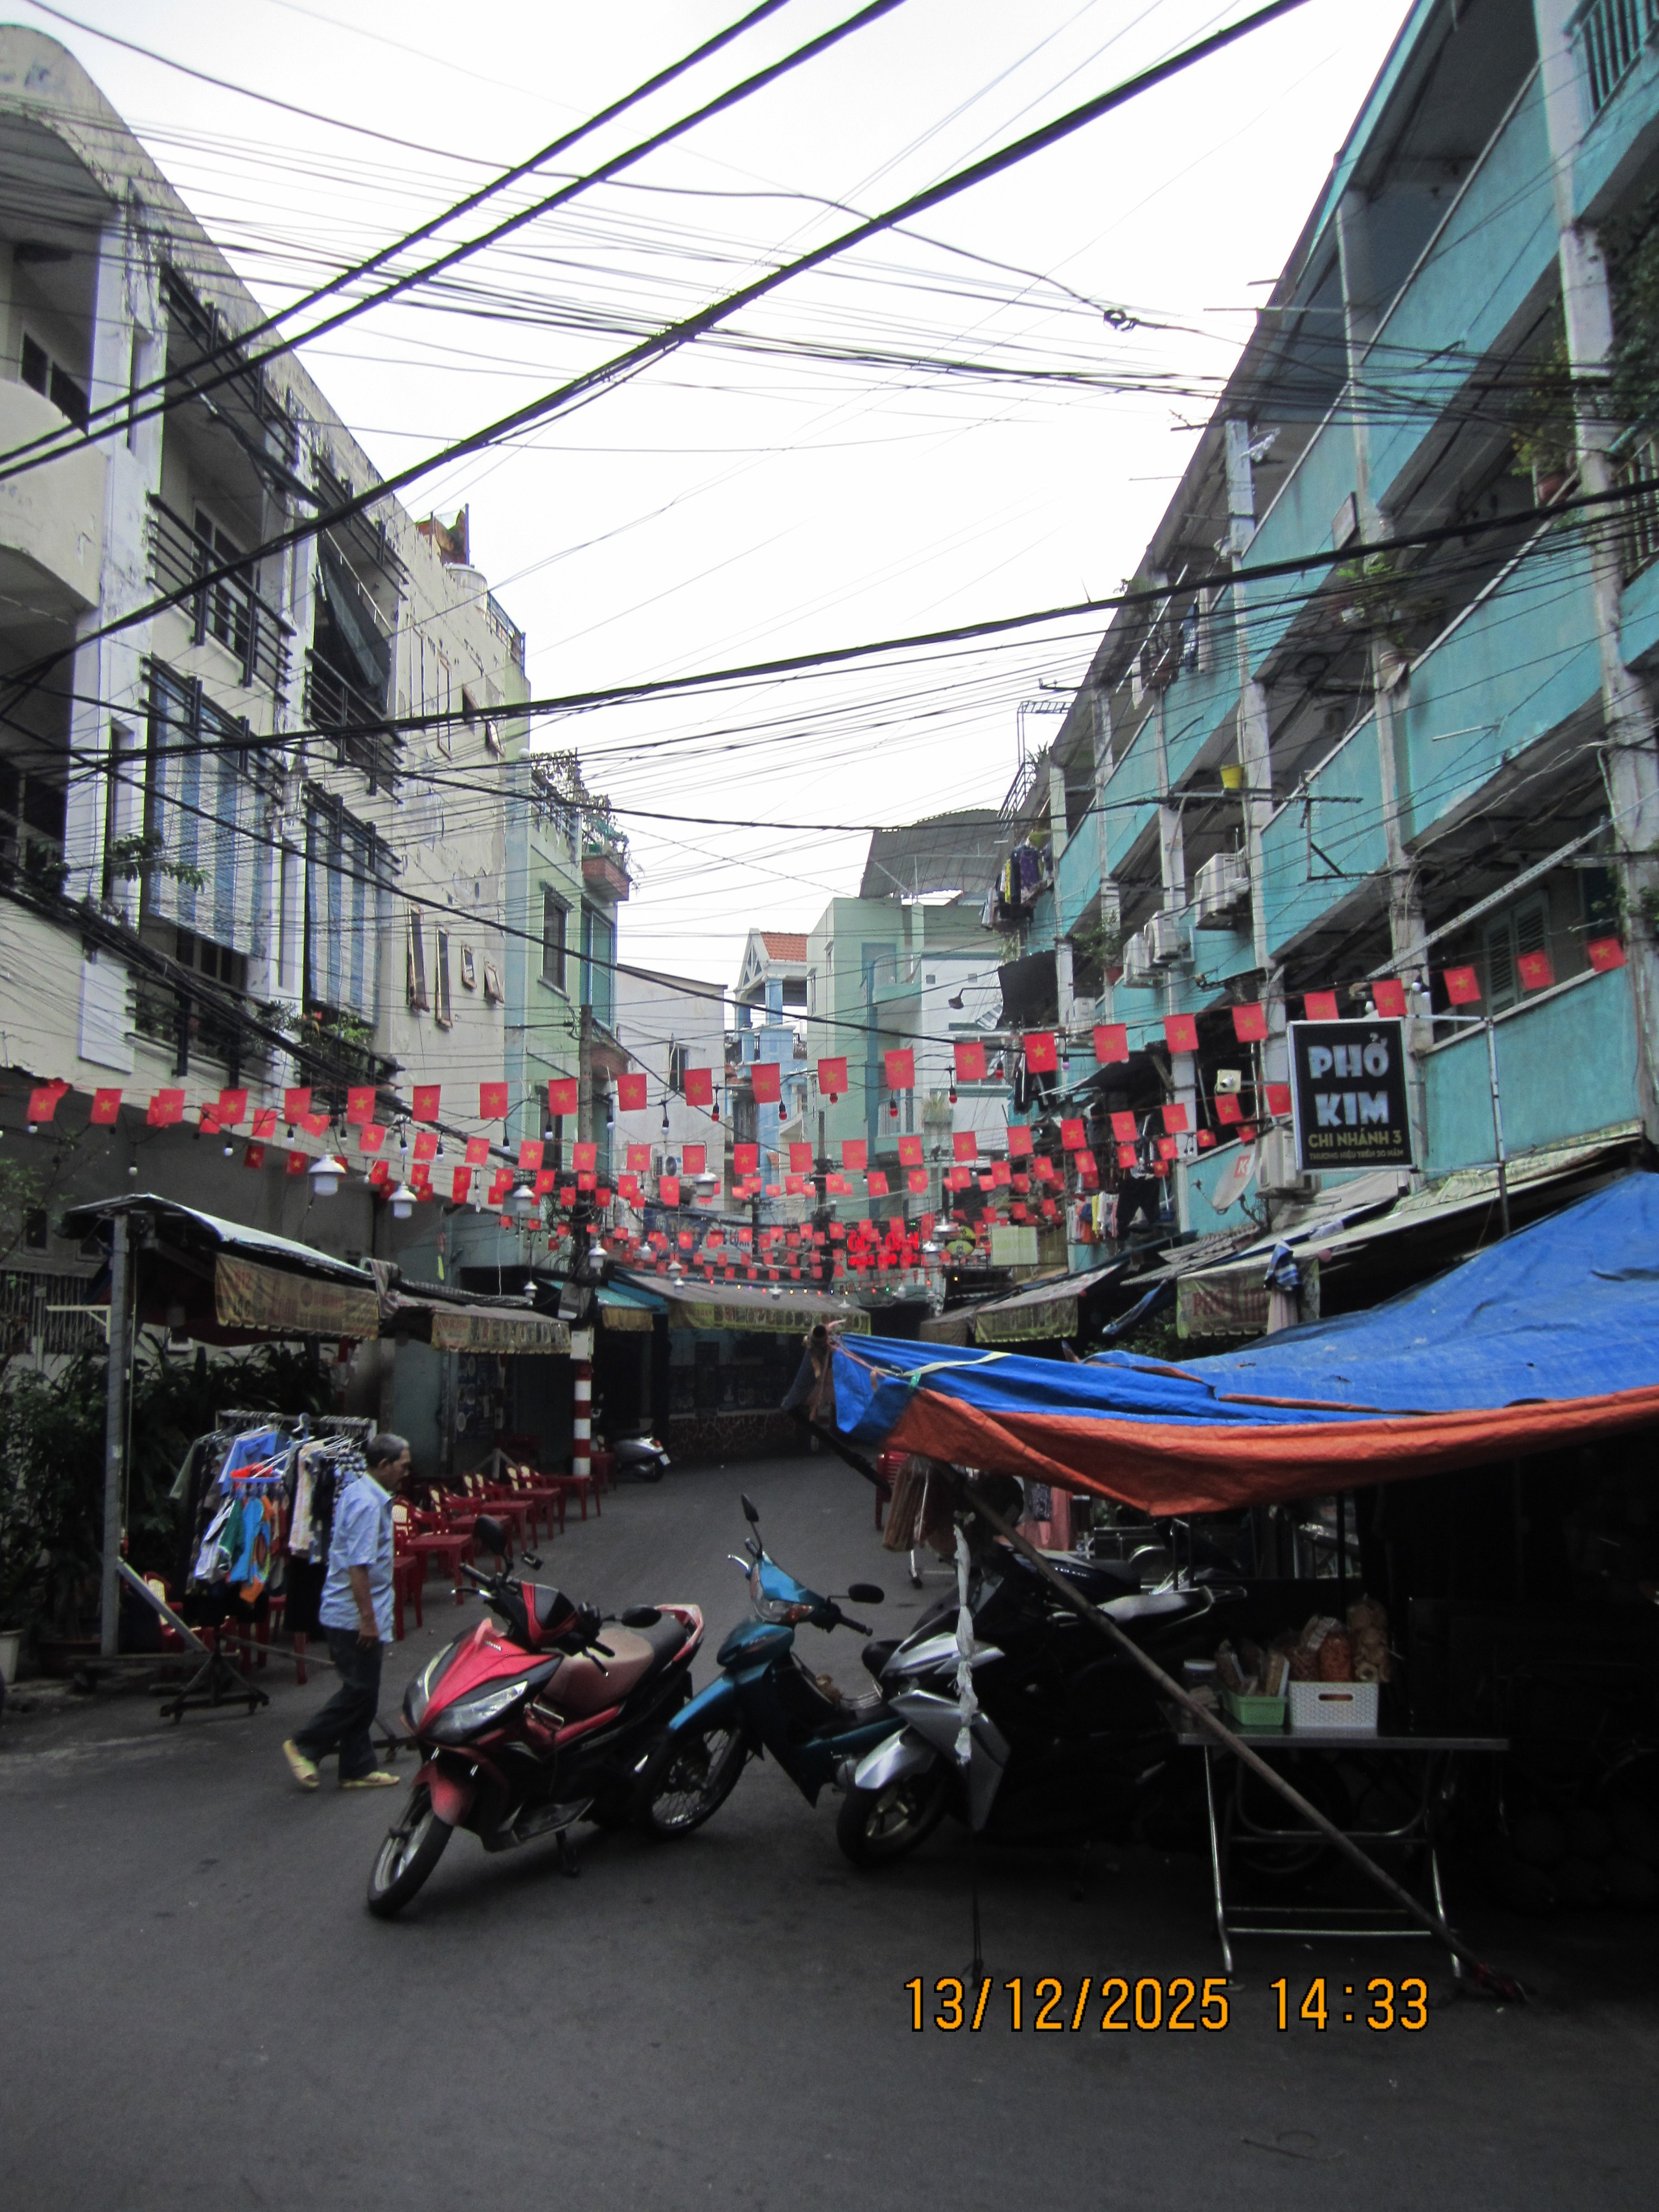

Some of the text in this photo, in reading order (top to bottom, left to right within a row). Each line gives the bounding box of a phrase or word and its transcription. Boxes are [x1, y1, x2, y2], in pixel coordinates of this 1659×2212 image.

[1308, 1032, 1389, 1078] PHỞ
[1315, 1090, 1389, 1126] KIM
[1308, 1128, 1402, 1148] CHI NHÁNH 3
